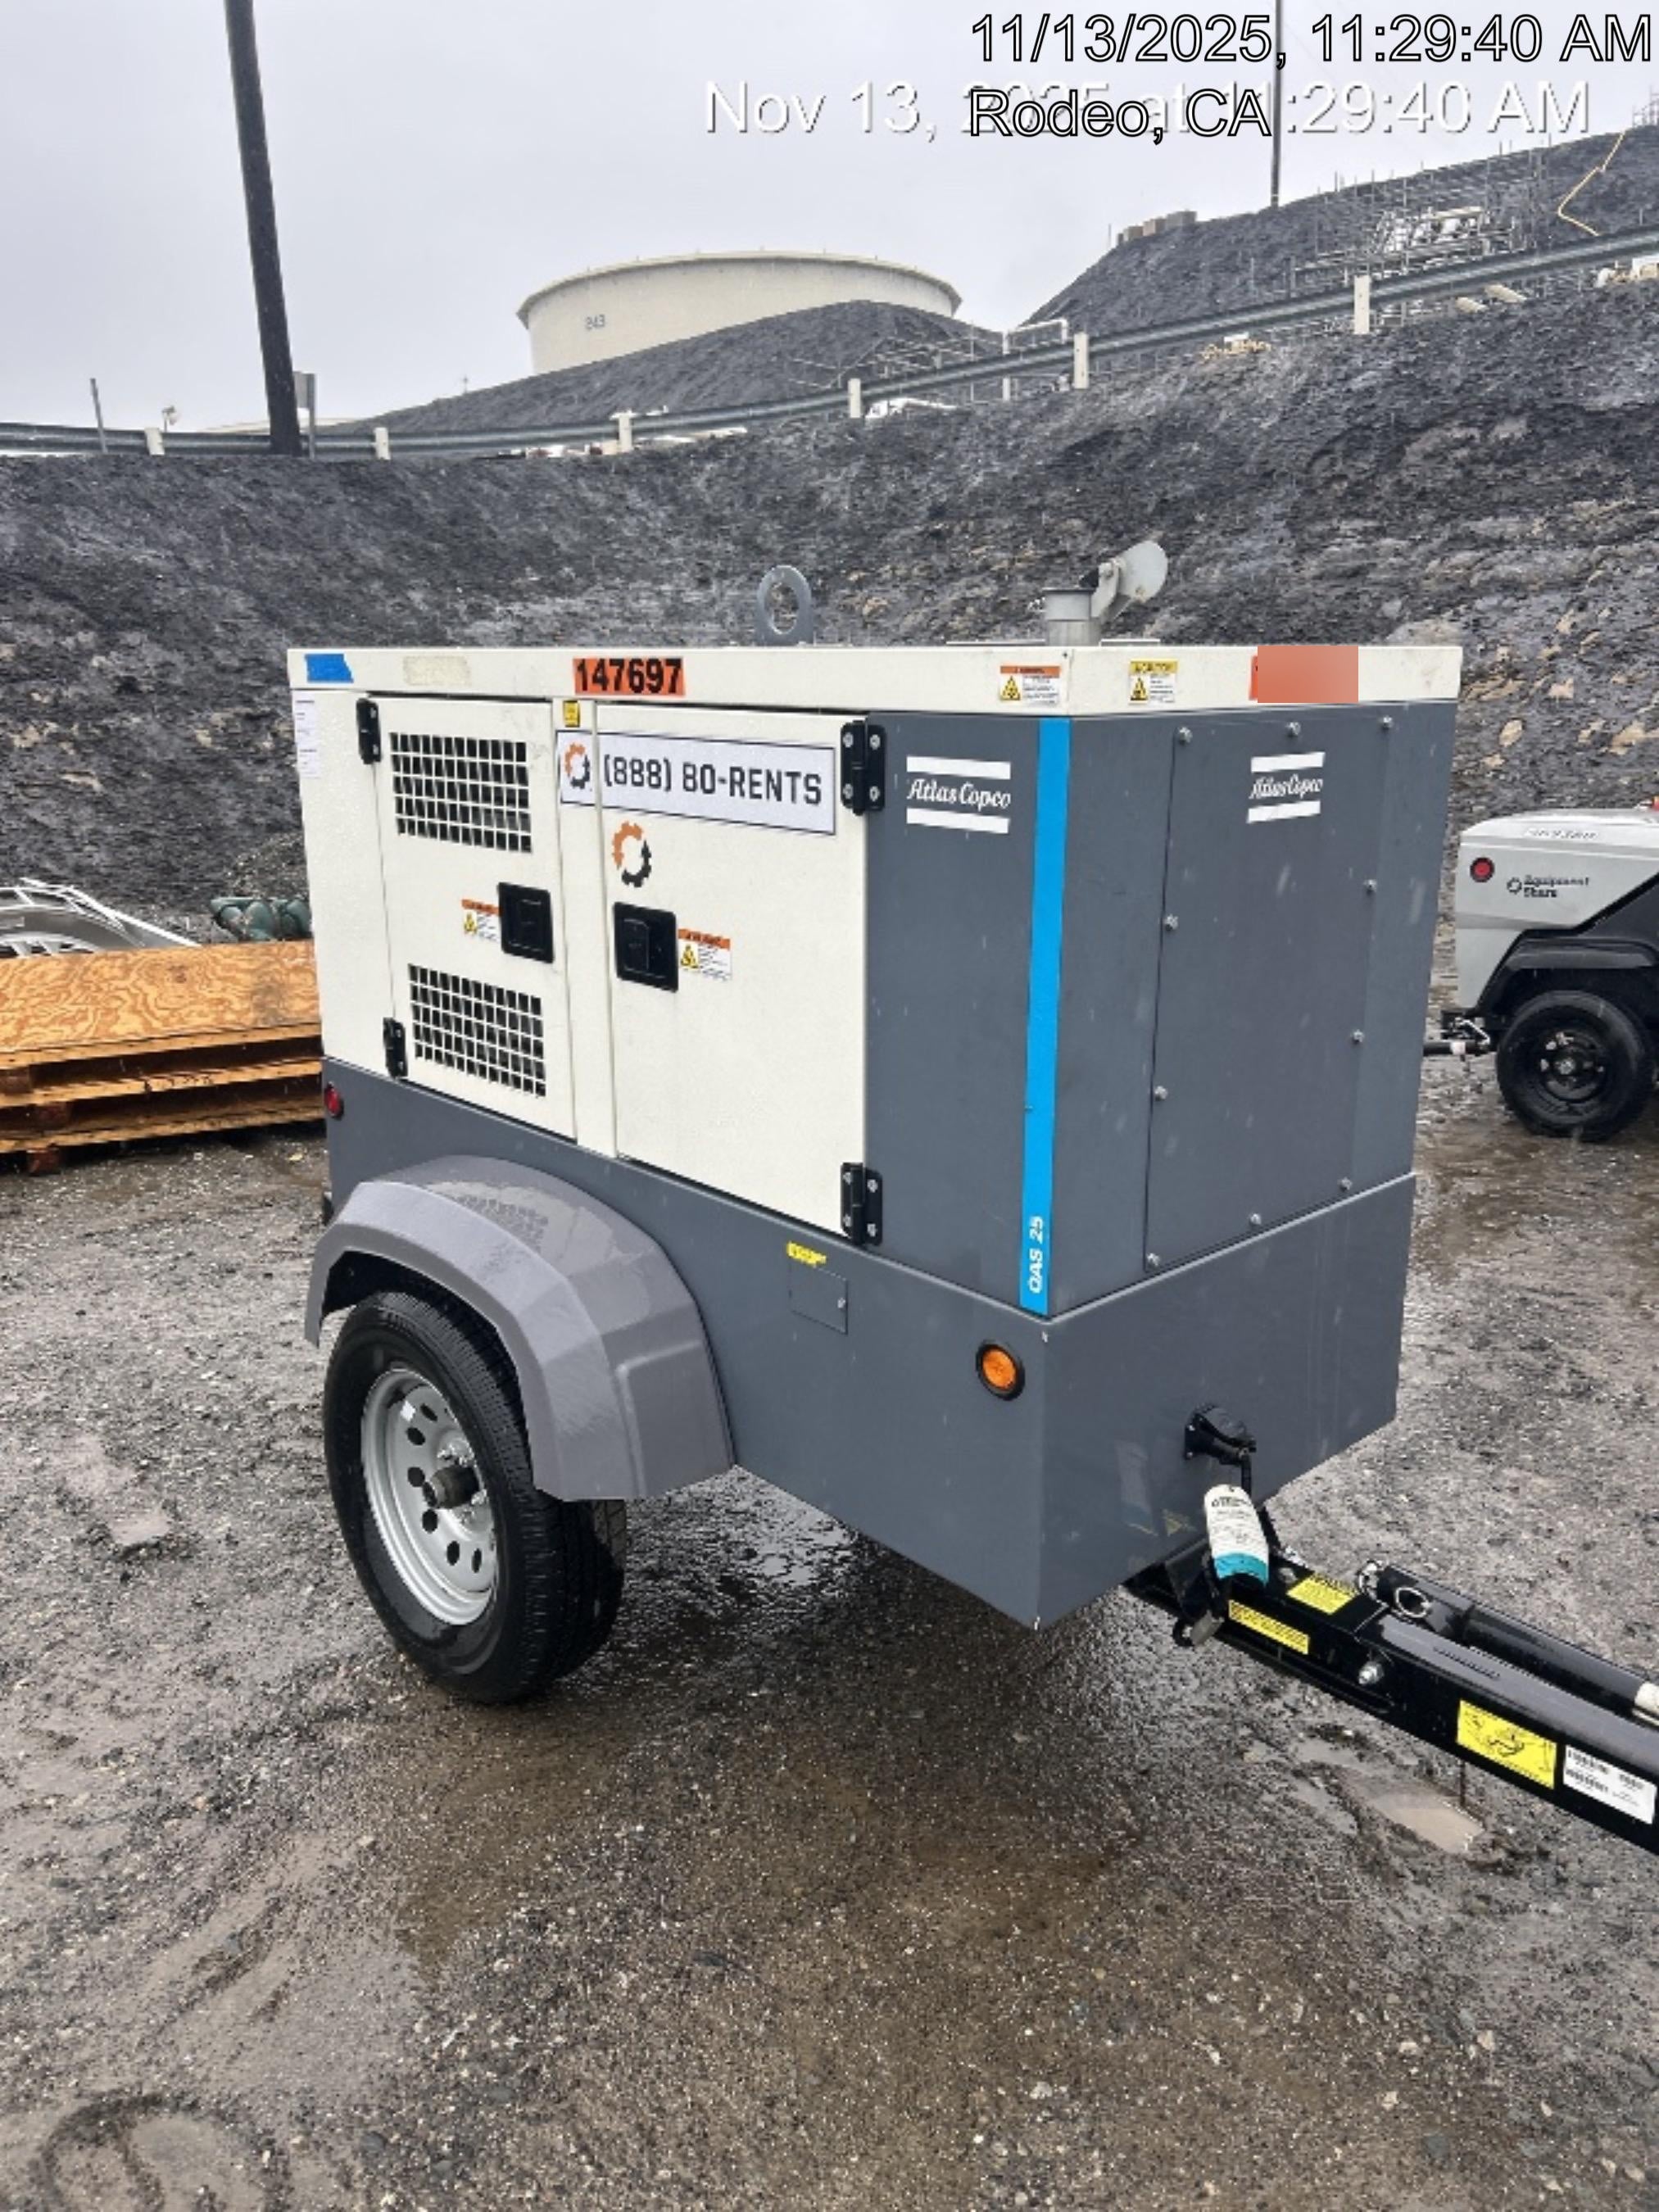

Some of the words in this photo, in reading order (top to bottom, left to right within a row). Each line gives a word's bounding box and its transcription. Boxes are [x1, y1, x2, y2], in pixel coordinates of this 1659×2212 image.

[576, 658, 682, 694] 147697
[603, 753, 672, 792] (888)
[906, 777, 957, 805] Atlas
[959, 782, 1012, 812] Copco
